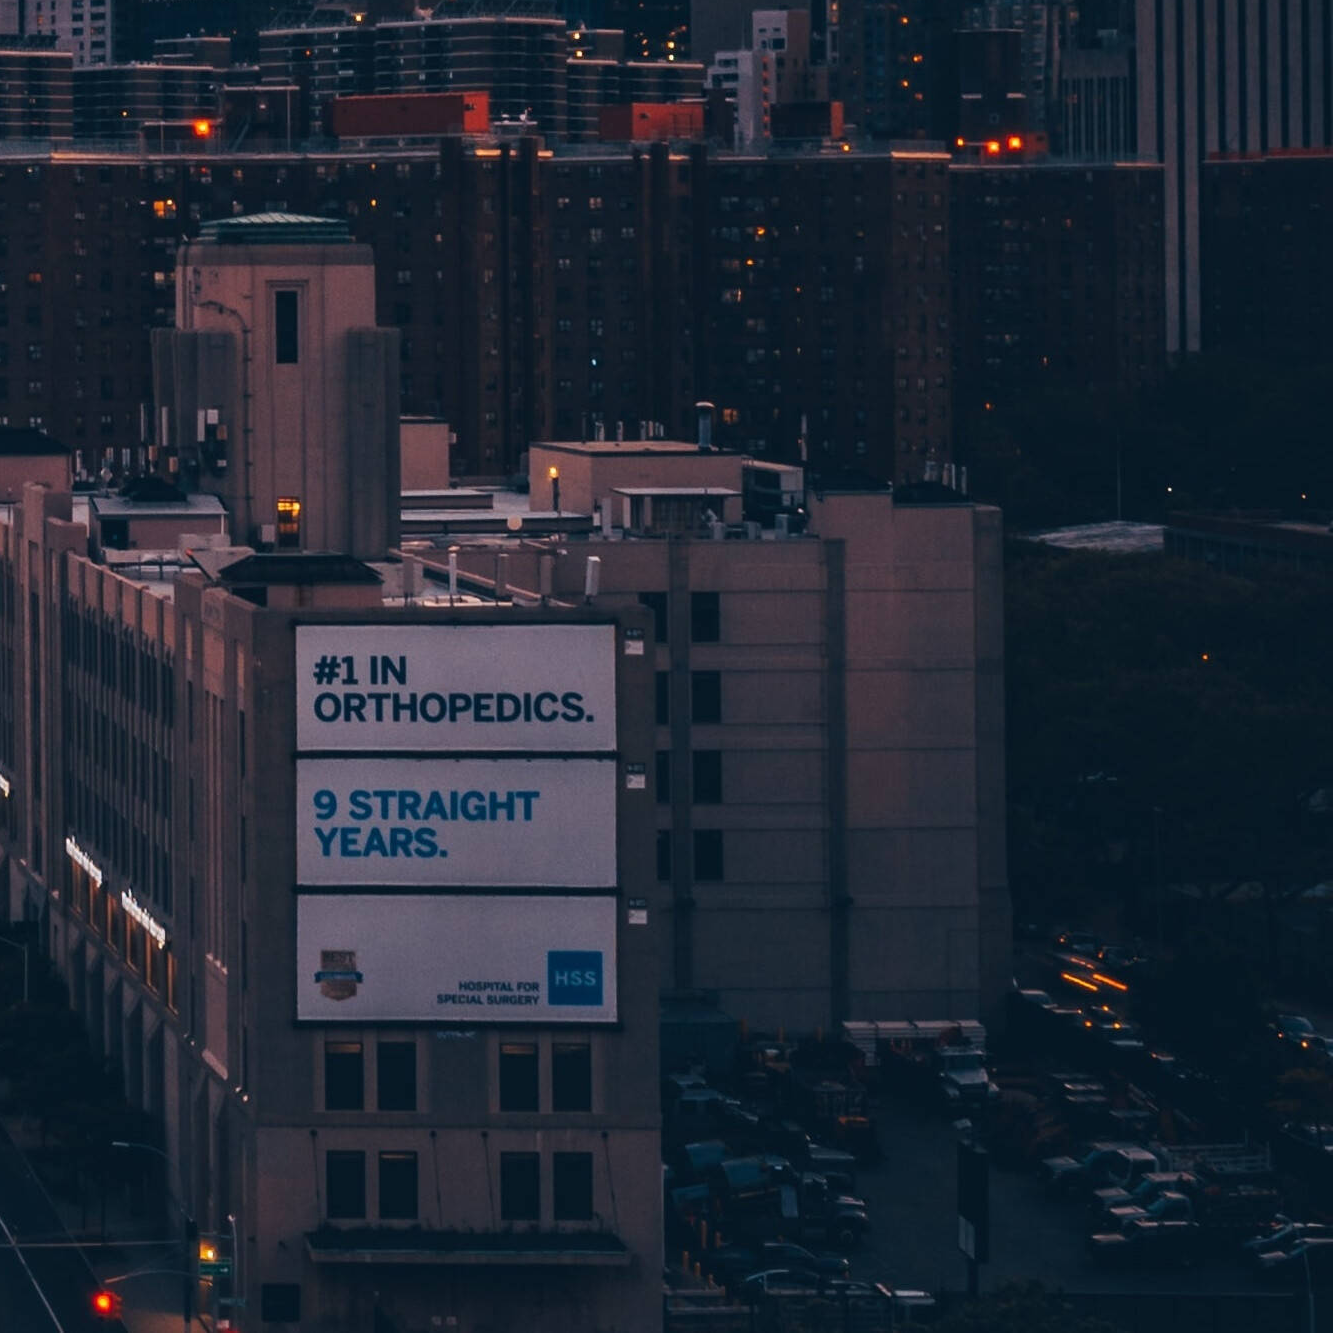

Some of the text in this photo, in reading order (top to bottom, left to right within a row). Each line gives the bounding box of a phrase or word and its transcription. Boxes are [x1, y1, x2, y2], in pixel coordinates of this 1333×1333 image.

[313, 655, 407, 685] #1 IN
[313, 692, 595, 723] ORTHOPEDICS.
[314, 789, 540, 821] 9 STRAIGHT
[314, 827, 448, 858] YEARS.
[459, 981, 540, 993] HOSPITAL FOR
[555, 970, 597, 986] HSS
[437, 994, 540, 1006] SPECIAL SURGERY
